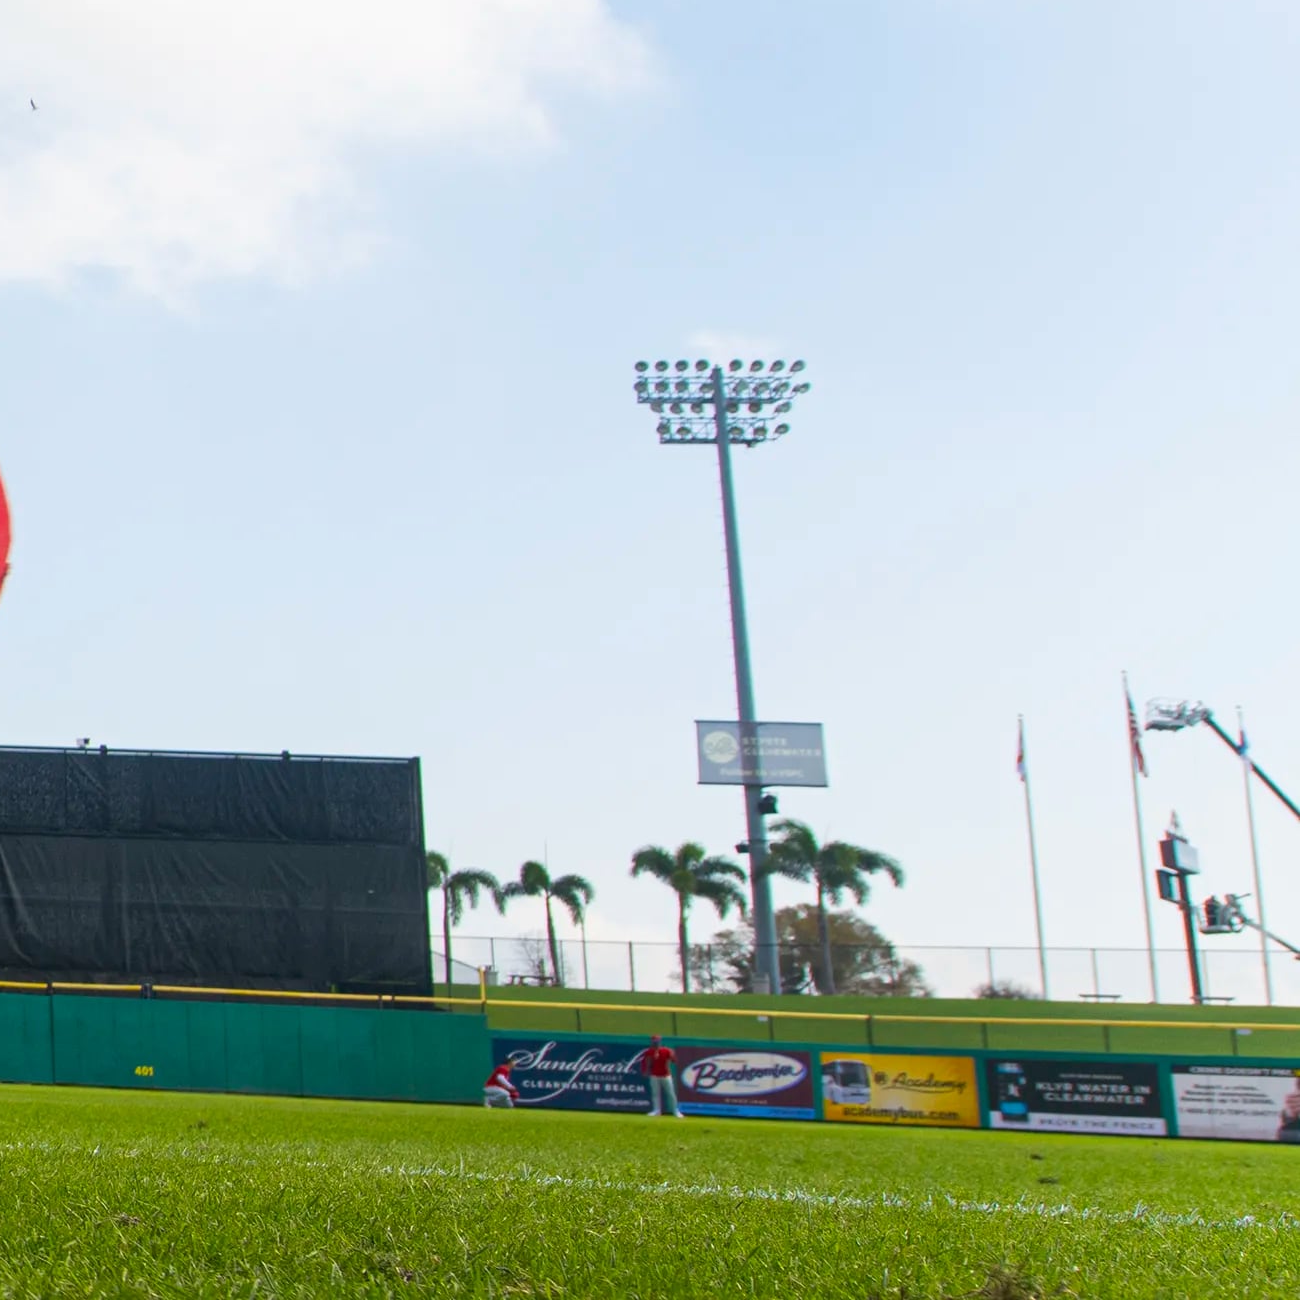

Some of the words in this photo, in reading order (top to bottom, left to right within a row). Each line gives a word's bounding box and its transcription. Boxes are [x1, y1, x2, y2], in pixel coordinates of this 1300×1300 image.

[508, 1041, 650, 1090] Sandpearl
[522, 1080, 602, 1092] CLEARWATER
[605, 1084, 646, 1093] BEACH
[892, 1072, 967, 1094] Academy
[1078, 1084, 1130, 1093] WATER
[1133, 1085, 1152, 1094] IN
[1043, 1093, 1145, 1104] CLEARWATER
[843, 1106, 960, 1121] academybus.com
